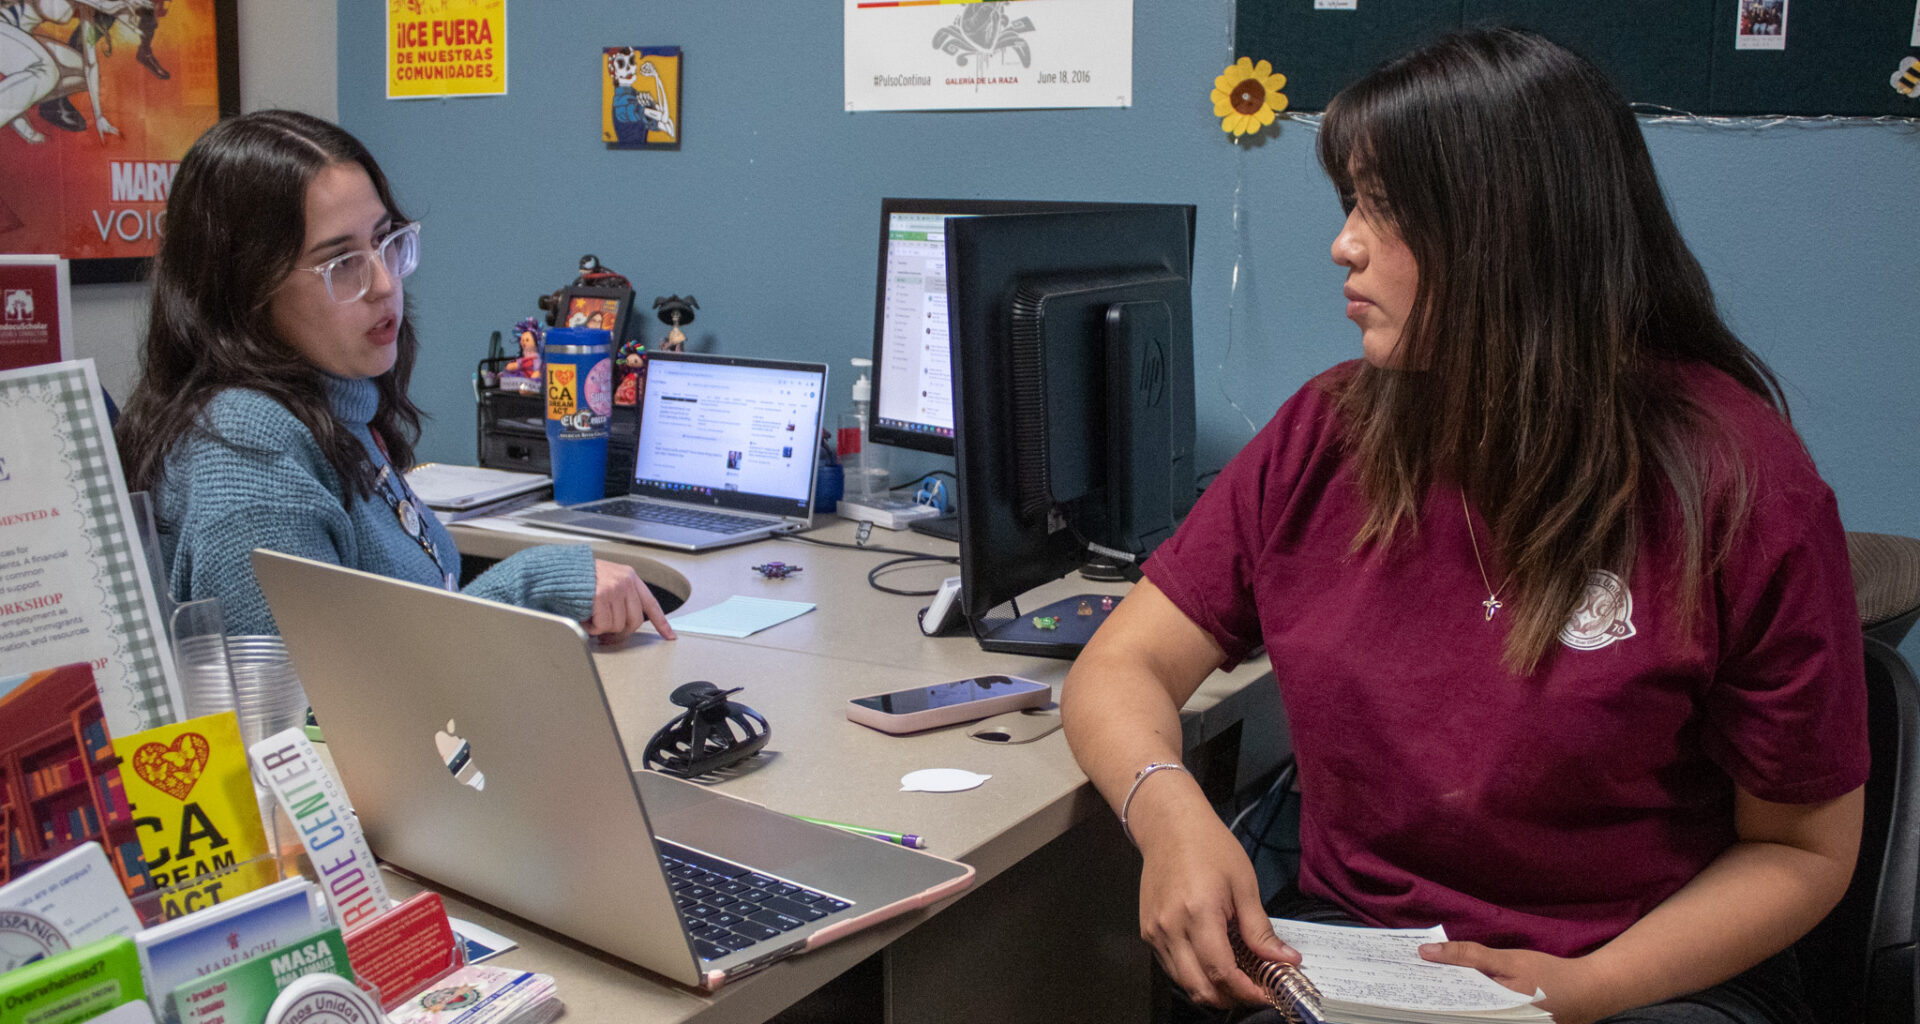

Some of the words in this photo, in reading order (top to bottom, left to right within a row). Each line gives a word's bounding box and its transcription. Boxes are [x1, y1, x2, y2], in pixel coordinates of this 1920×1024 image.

[432, 18, 492, 46] FUERA
[397, 52, 413, 64] DE
[418, 47, 493, 63] NUESTRAS
[396, 64, 493, 81] COMUNIDADES
[874, 75, 931, 87] #PulsoContinua
[1037, 71, 1056, 84] June
[1072, 70, 1091, 83] 2016
[111, 161, 180, 201] MARV
[549, 370, 554, 385] I
[549, 386, 573, 401] CA
[51, 507, 60, 517] &
[31, 550, 68, 563] financial
[5, 568, 45, 580] common
[59, 607, 68, 615] as
[31, 636, 47, 646] and
[49, 628, 89, 641] resources
[1612, 623, 1625, 634] 10
[262, 744, 346, 852] CENTER
[338, 804, 362, 845] RIVER
[135, 801, 229, 871] CA
[152, 850, 239, 895] REAM
[320, 849, 378, 927] RIDE
[270, 939, 332, 976] MASA
[6, 959, 105, 1010] Overwhelmed?
[315, 997, 358, 1023] Unidos
